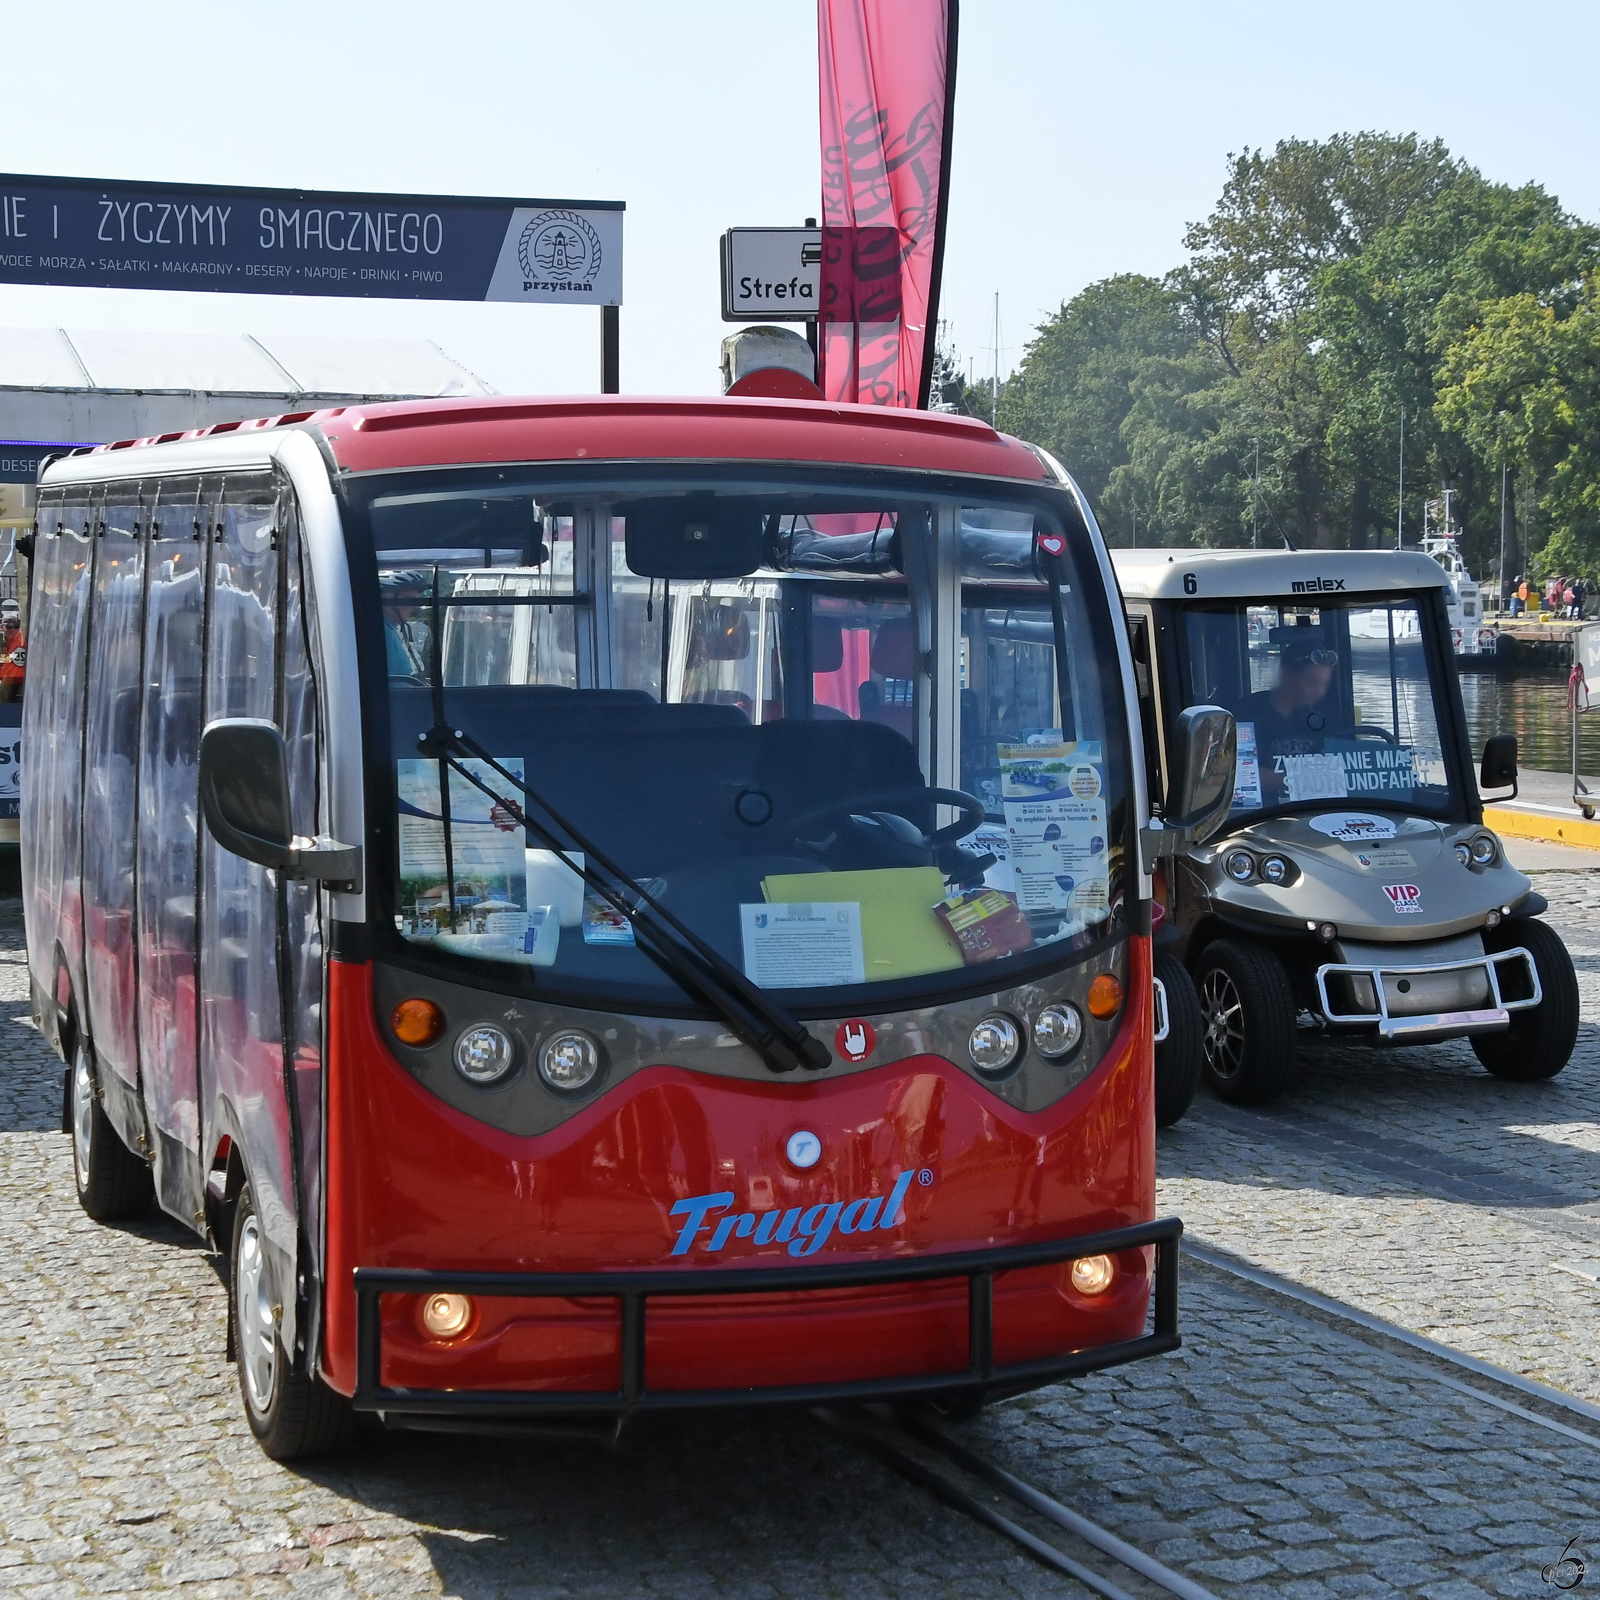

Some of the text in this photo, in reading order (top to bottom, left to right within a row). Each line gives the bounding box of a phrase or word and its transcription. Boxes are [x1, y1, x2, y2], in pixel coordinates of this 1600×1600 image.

[4, 194, 443, 255] IE I ŻYCZYMY SMACZNEGO
[39, 256, 87, 269] MORZA
[99, 258, 150, 271] SAŁATKI
[162, 261, 233, 275] MAKARONY
[245, 264, 292, 277] DESERY
[304, 267, 348, 281] NAPOJE
[360, 268, 400, 281] DRINKI
[412, 270, 443, 282] PIWO
[523, 279, 593, 292] przystań
[739, 276, 813, 299] Strefa
[1183, 572, 1198, 595] 6
[1291, 576, 1346, 593] melex
[1273, 748, 1436, 774] ZWIEDZANIE MIASTA
[1284, 769, 1430, 795] STADTRUNDFAHRT
[1331, 826, 1361, 836] city
[1385, 886, 1419, 901] VIP
[669, 1169, 915, 1257] Frugal
